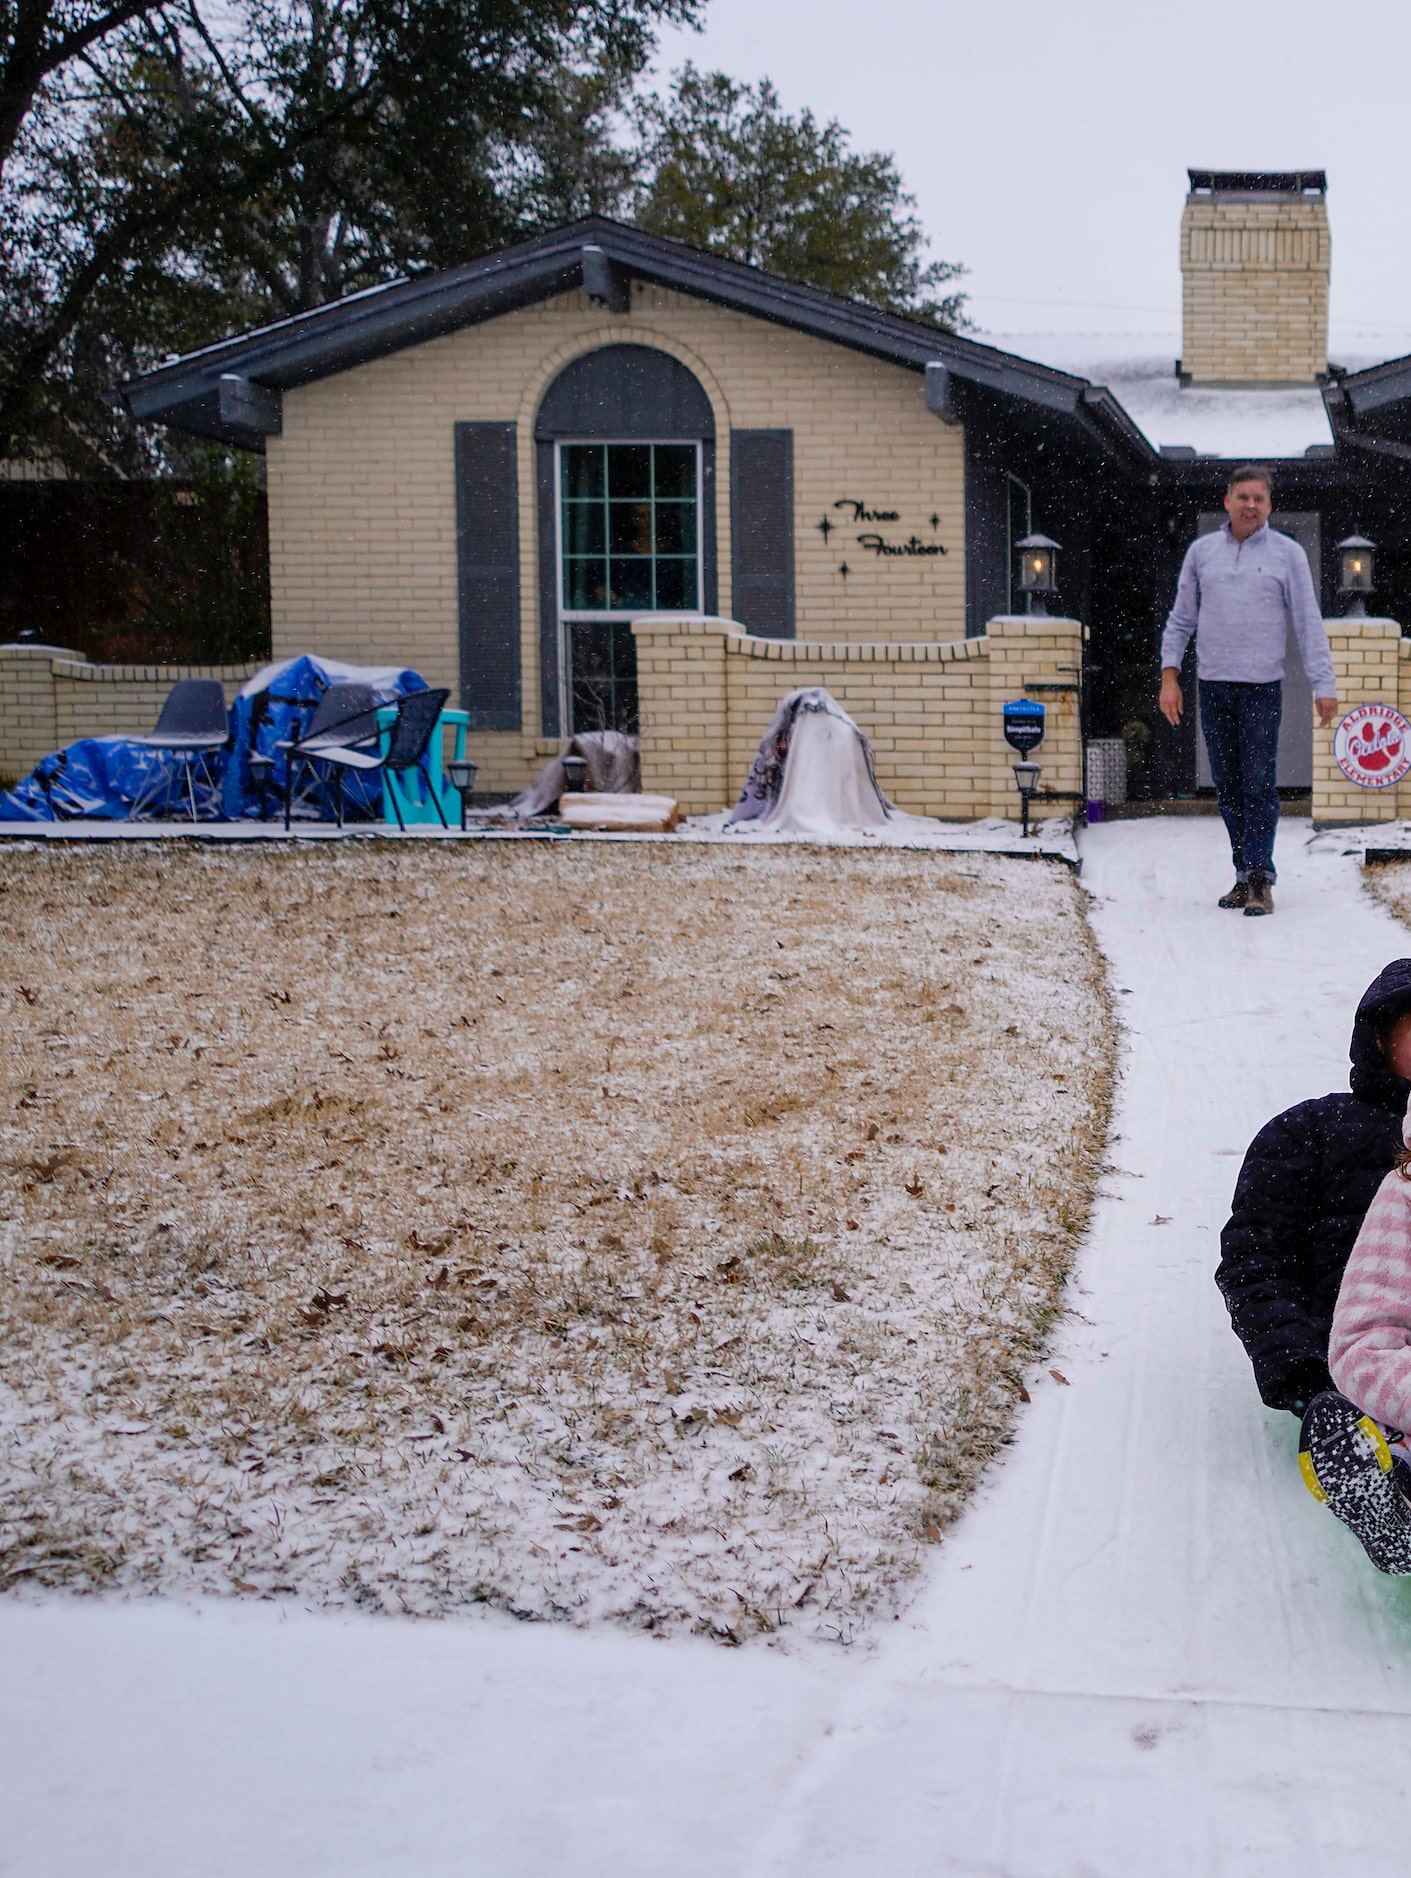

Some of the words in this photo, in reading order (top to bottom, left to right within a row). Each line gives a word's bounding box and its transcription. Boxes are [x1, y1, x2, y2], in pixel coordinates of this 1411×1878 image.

[834, 499, 900, 522] Three
[856, 533, 949, 557] Fourteen
[1342, 706, 1409, 733] ALDRIDGE
[1339, 757, 1410, 786] ELEMENTARY
